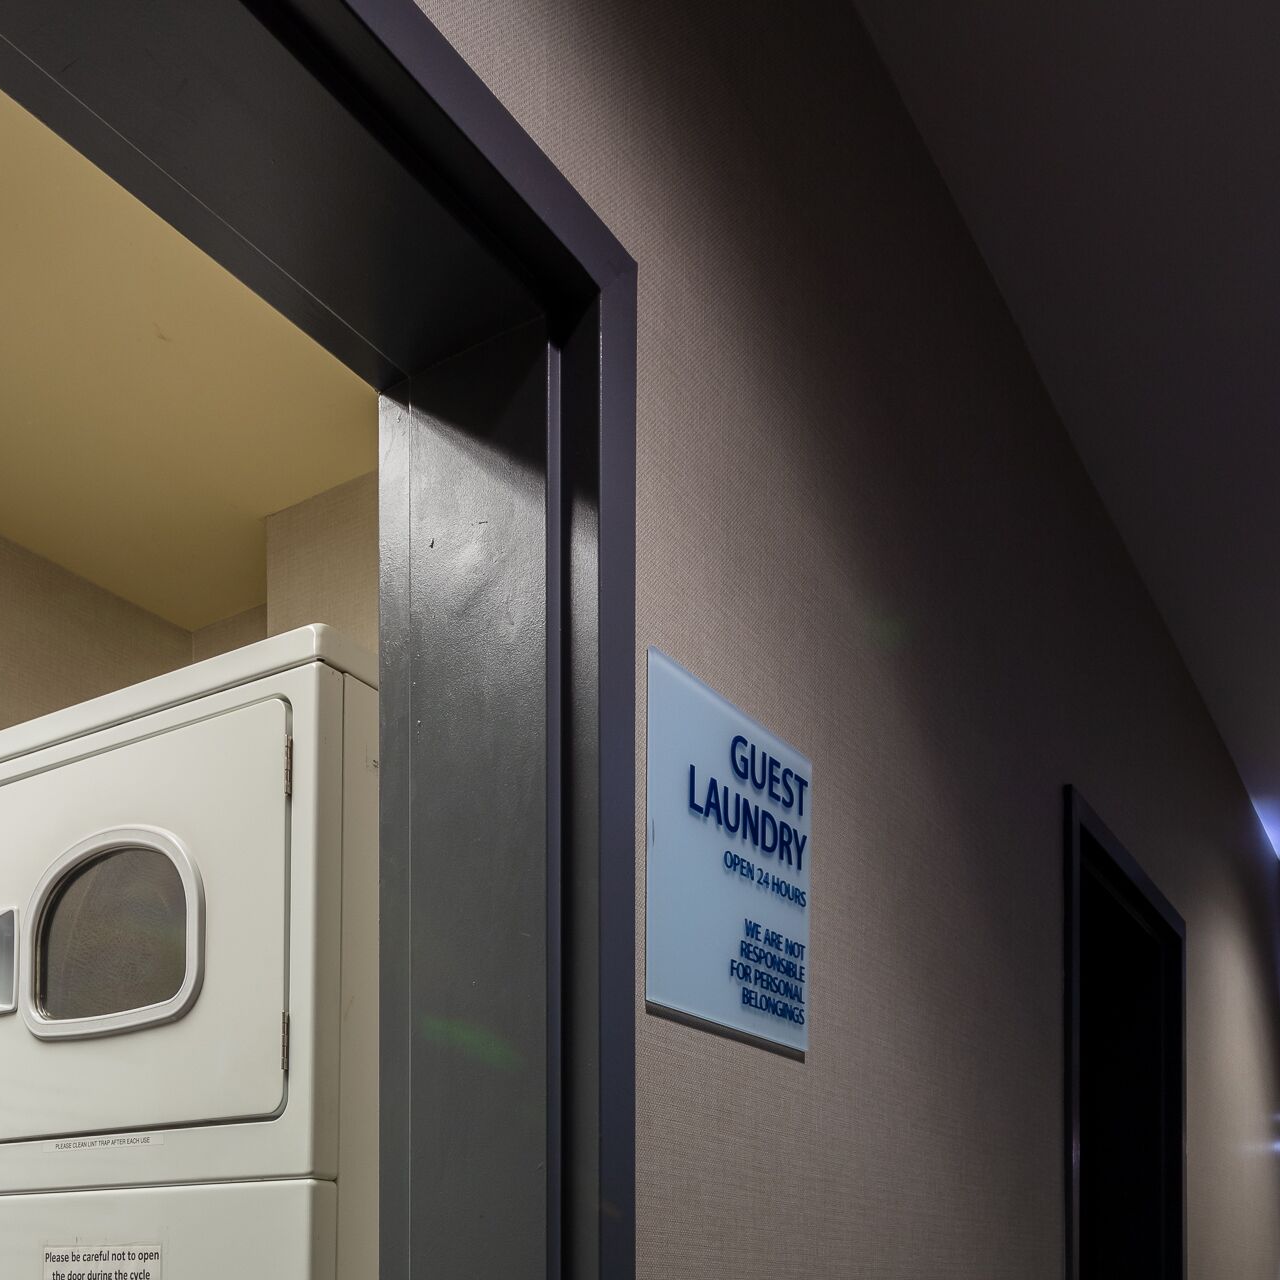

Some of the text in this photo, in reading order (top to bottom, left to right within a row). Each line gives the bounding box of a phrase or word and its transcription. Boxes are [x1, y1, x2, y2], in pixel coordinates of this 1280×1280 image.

[730, 734, 808, 816] GUEST
[688, 764, 807, 871] LAUNDRY
[724, 850, 807, 908] OPEN 24 HOURS
[744, 918, 805, 961] WE ARE NOT
[730, 960, 805, 1005] FOR PERSONAL
[740, 941, 805, 983] RESPONSIBLE
[742, 986, 805, 1025] BELONGINGS
[45, 1251, 159, 1262] Please be careful not to open
[52, 1271, 65, 1280] the
[67, 1270, 85, 1280] door
[114, 1270, 127, 1280] the
